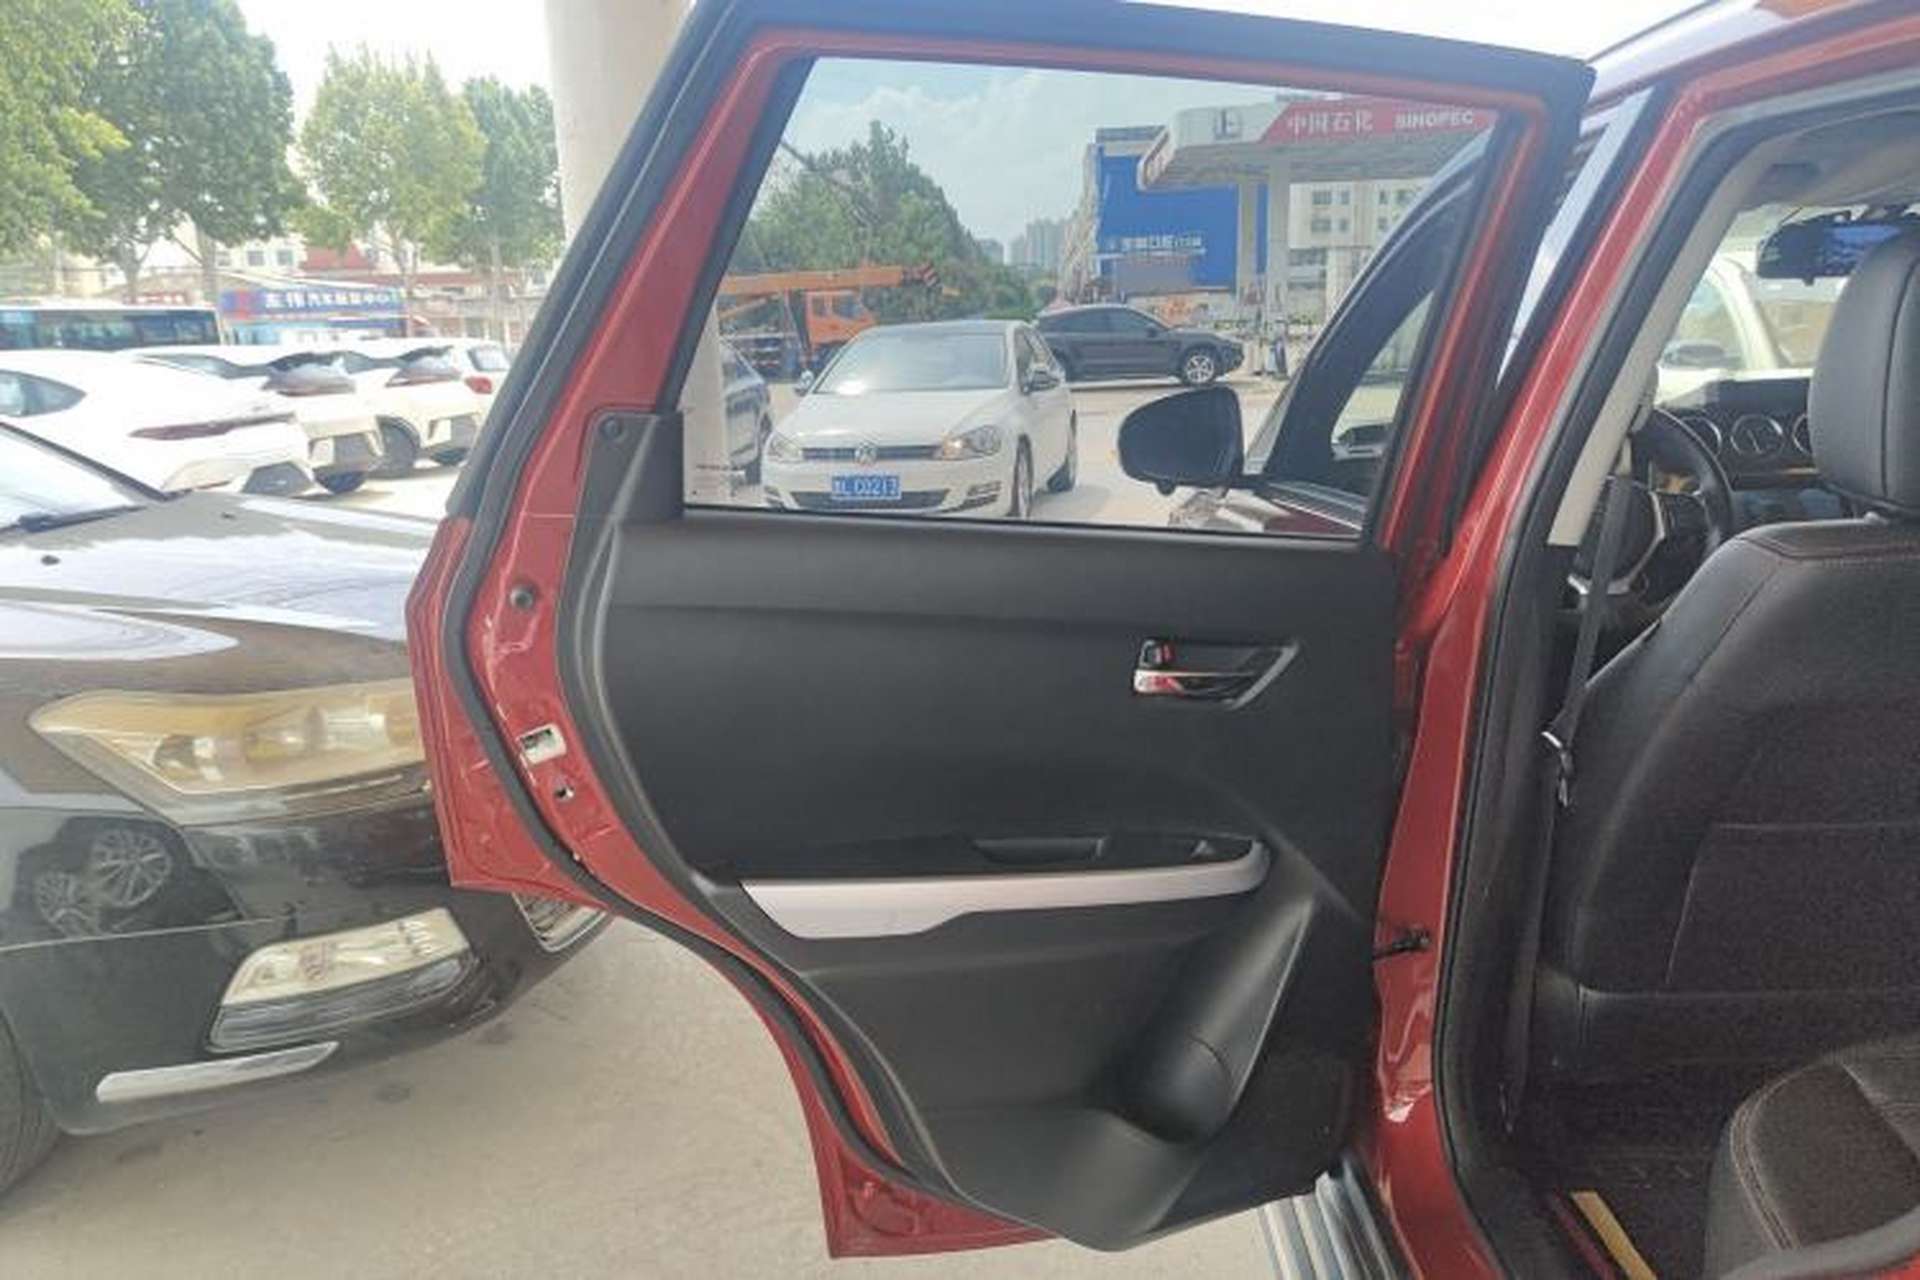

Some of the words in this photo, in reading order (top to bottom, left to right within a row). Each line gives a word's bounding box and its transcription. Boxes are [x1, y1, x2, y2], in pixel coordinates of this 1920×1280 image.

[1288, 109, 1374, 135] 中国石化
[1394, 109, 1475, 130] SINOPEC
